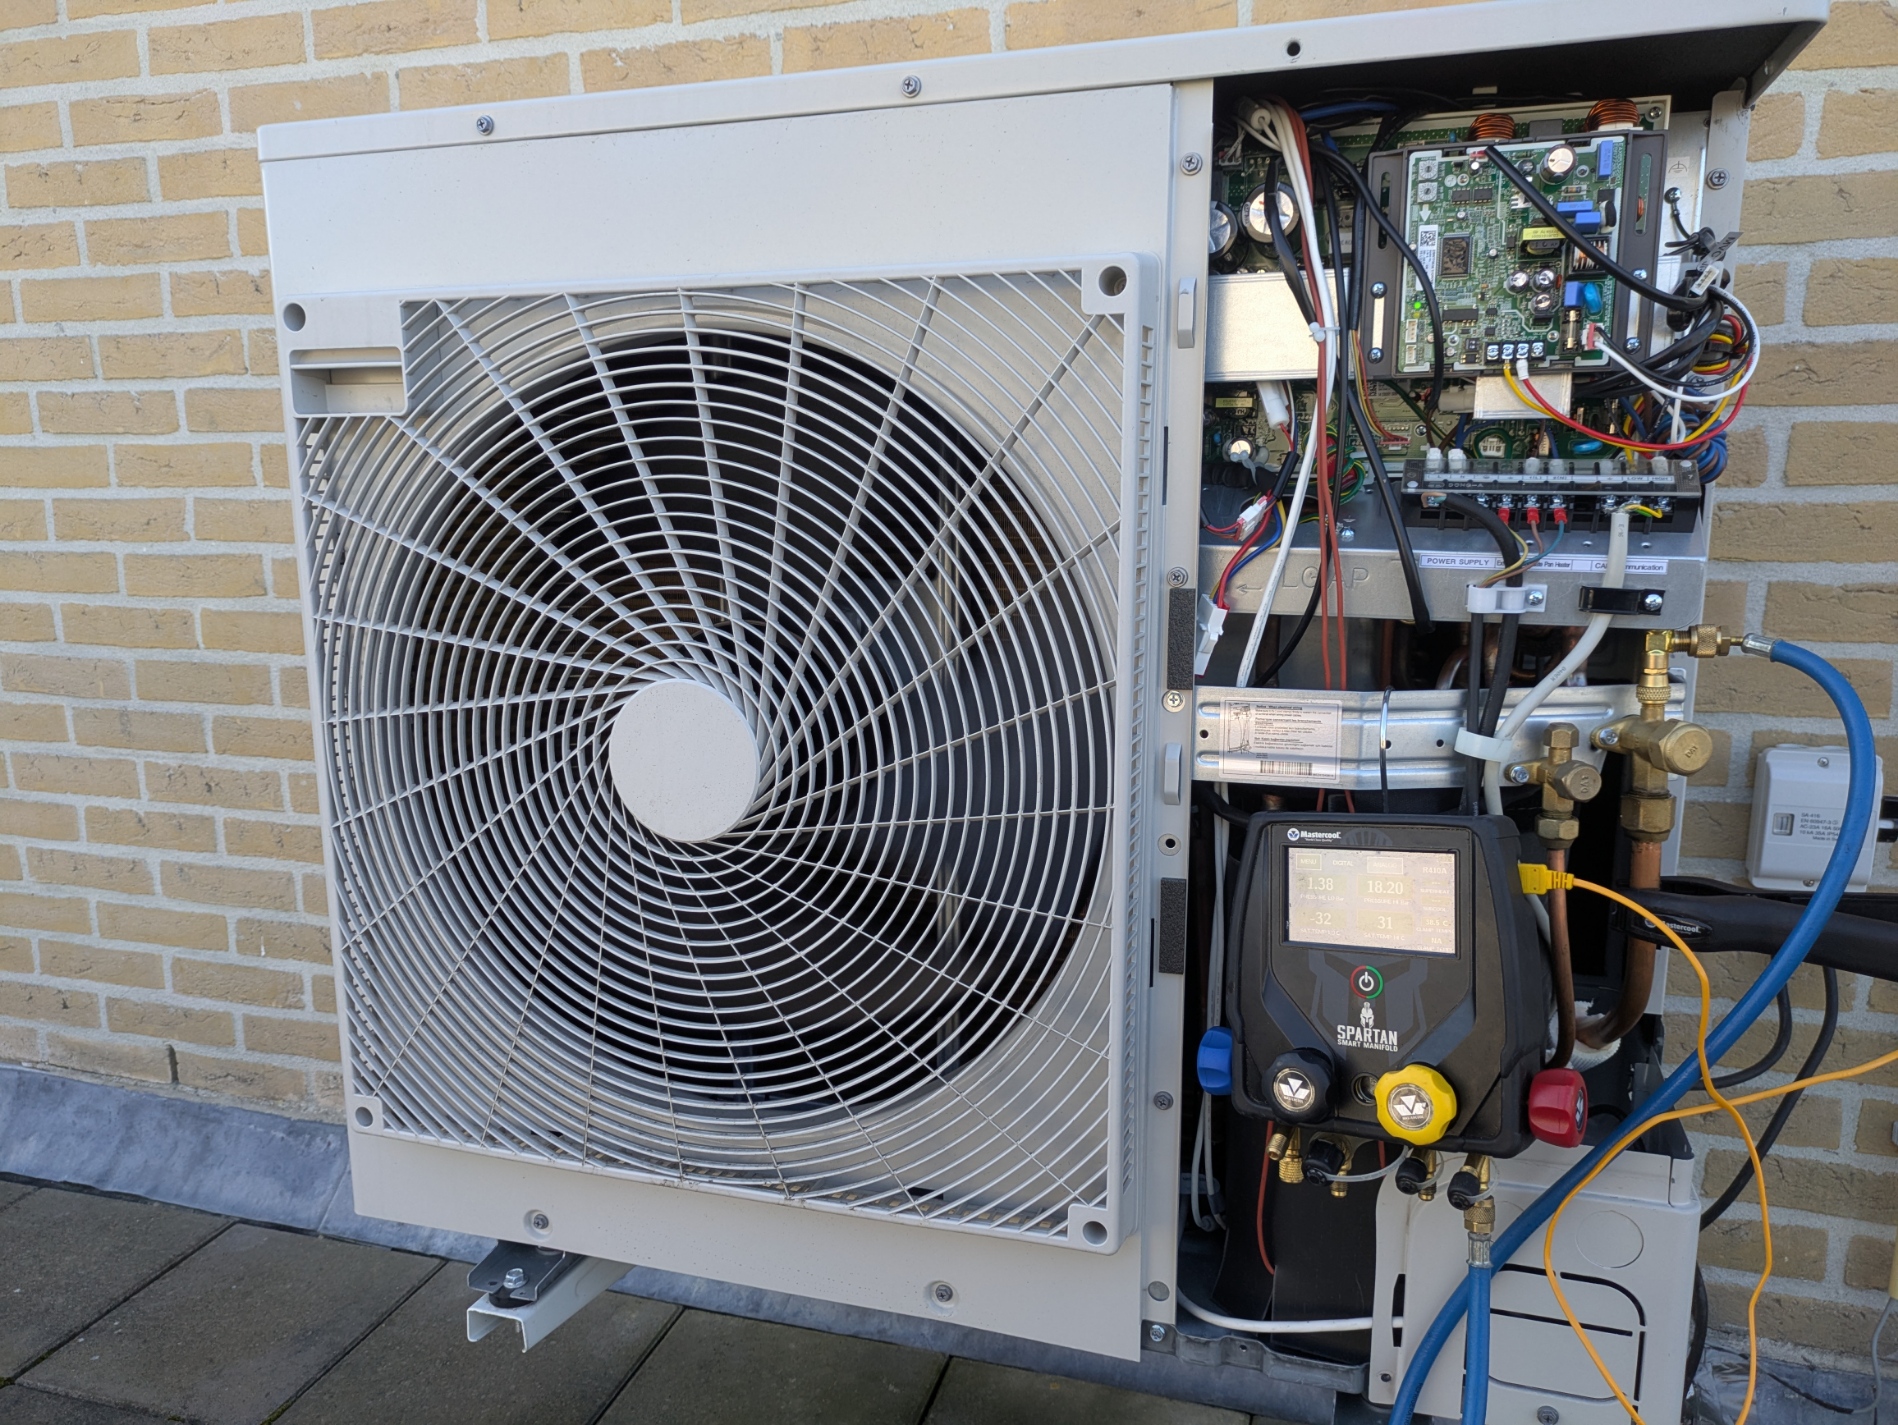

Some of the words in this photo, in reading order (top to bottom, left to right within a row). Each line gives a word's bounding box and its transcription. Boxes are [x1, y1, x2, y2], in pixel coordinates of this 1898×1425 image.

[1427, 557, 1456, 565] POWER
[1300, 830, 1341, 839] Mastercool
[1422, 866, 1448, 875] R410A
[1307, 877, 1334, 891] 1.38
[1367, 880, 1404, 895] 18.20
[1309, 911, 1333, 925] -32
[1377, 915, 1394, 930] 31
[1431, 937, 1443, 945] NA
[1337, 1024, 1398, 1046] SPARTAN
[1337, 1039, 1361, 1048] SMART
[1363, 1042, 1398, 1053] MANIFOLD
